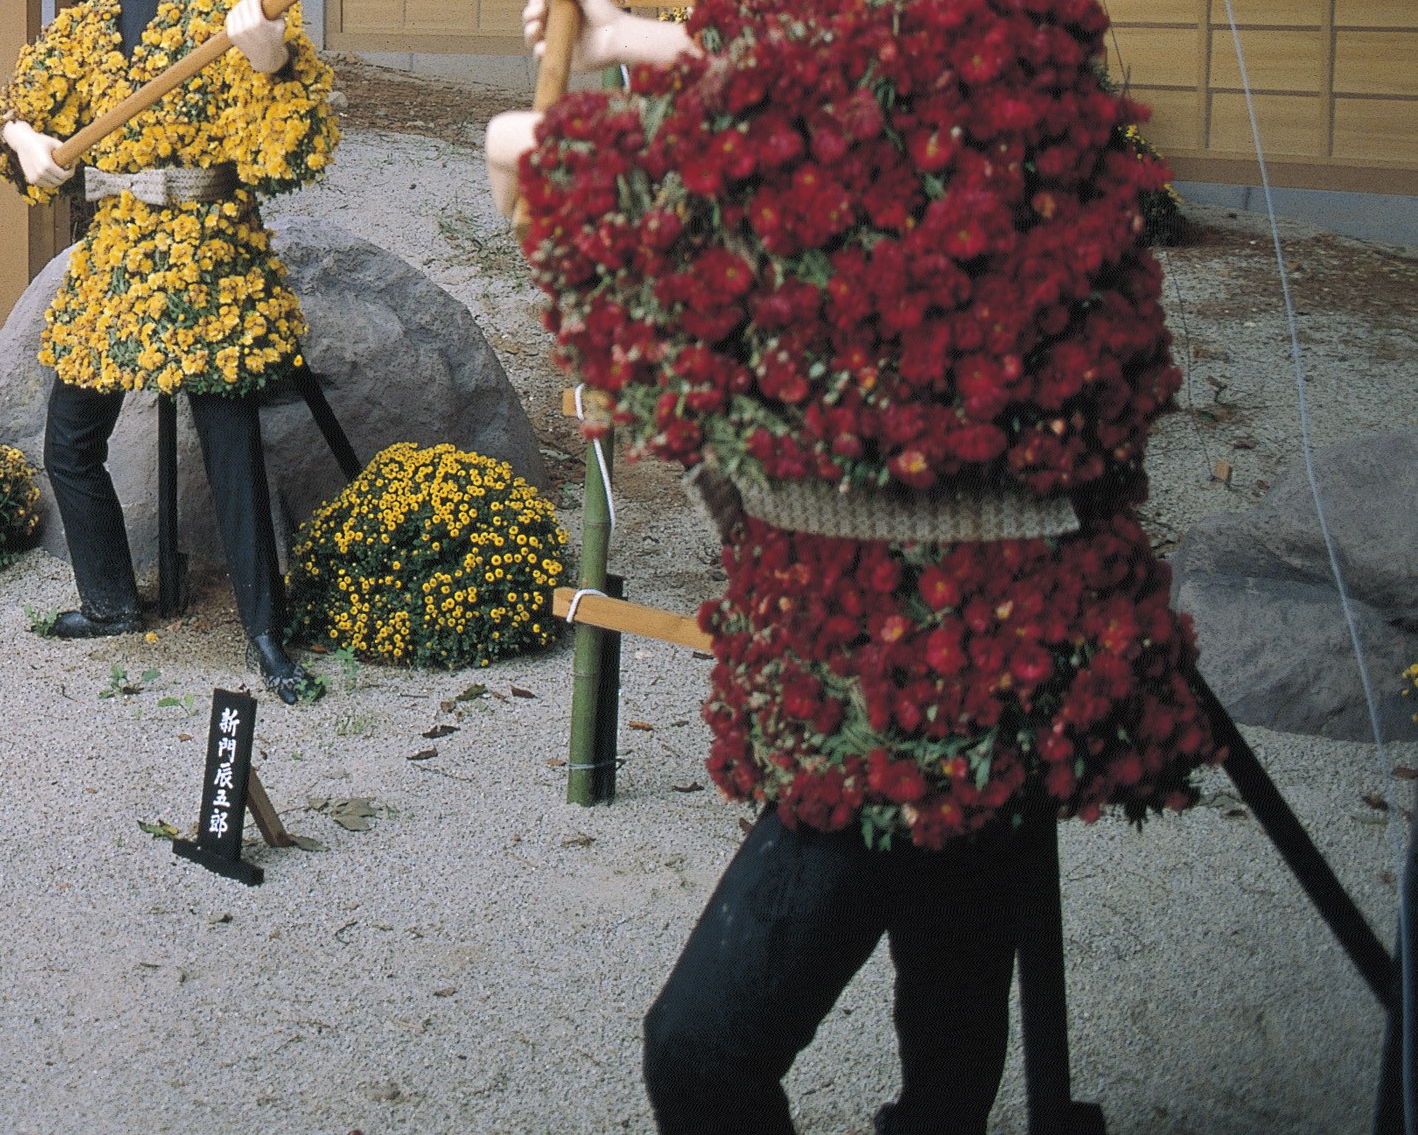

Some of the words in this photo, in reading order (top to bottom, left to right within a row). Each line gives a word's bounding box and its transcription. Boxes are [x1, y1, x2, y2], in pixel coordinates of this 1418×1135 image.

[208, 707, 240, 838] 新門辰五郎
